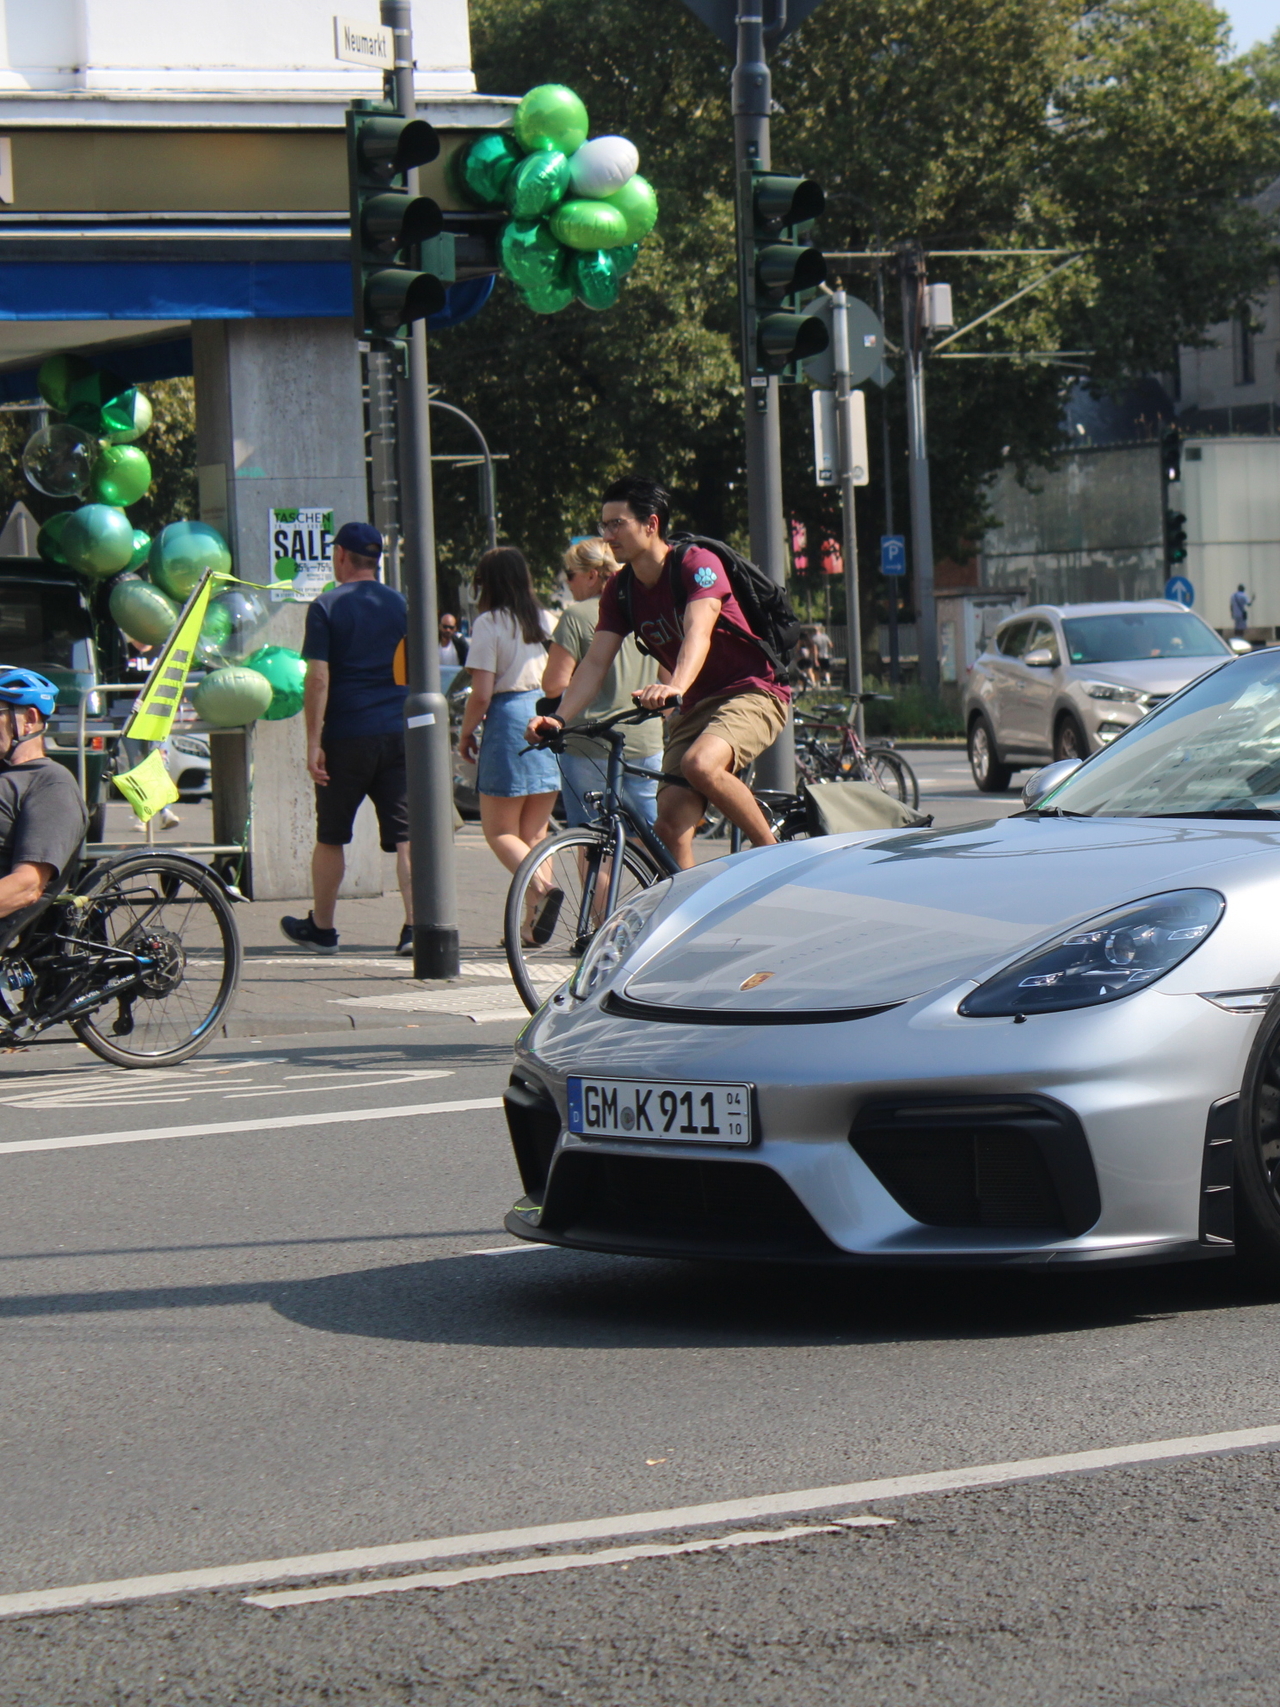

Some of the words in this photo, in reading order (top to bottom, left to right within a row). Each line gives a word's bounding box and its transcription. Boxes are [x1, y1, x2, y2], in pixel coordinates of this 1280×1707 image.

[344, 26, 387, 58] Neumarkt
[274, 513, 331, 523] TASCHEN
[274, 530, 331, 561] SALE
[889, 545, 899, 560] P
[126, 657, 158, 671] FIL
[727, 1093, 741, 1105] 04
[572, 1111, 579, 1123] D
[585, 1086, 618, 1129] GM
[729, 1123, 741, 1135] 10
